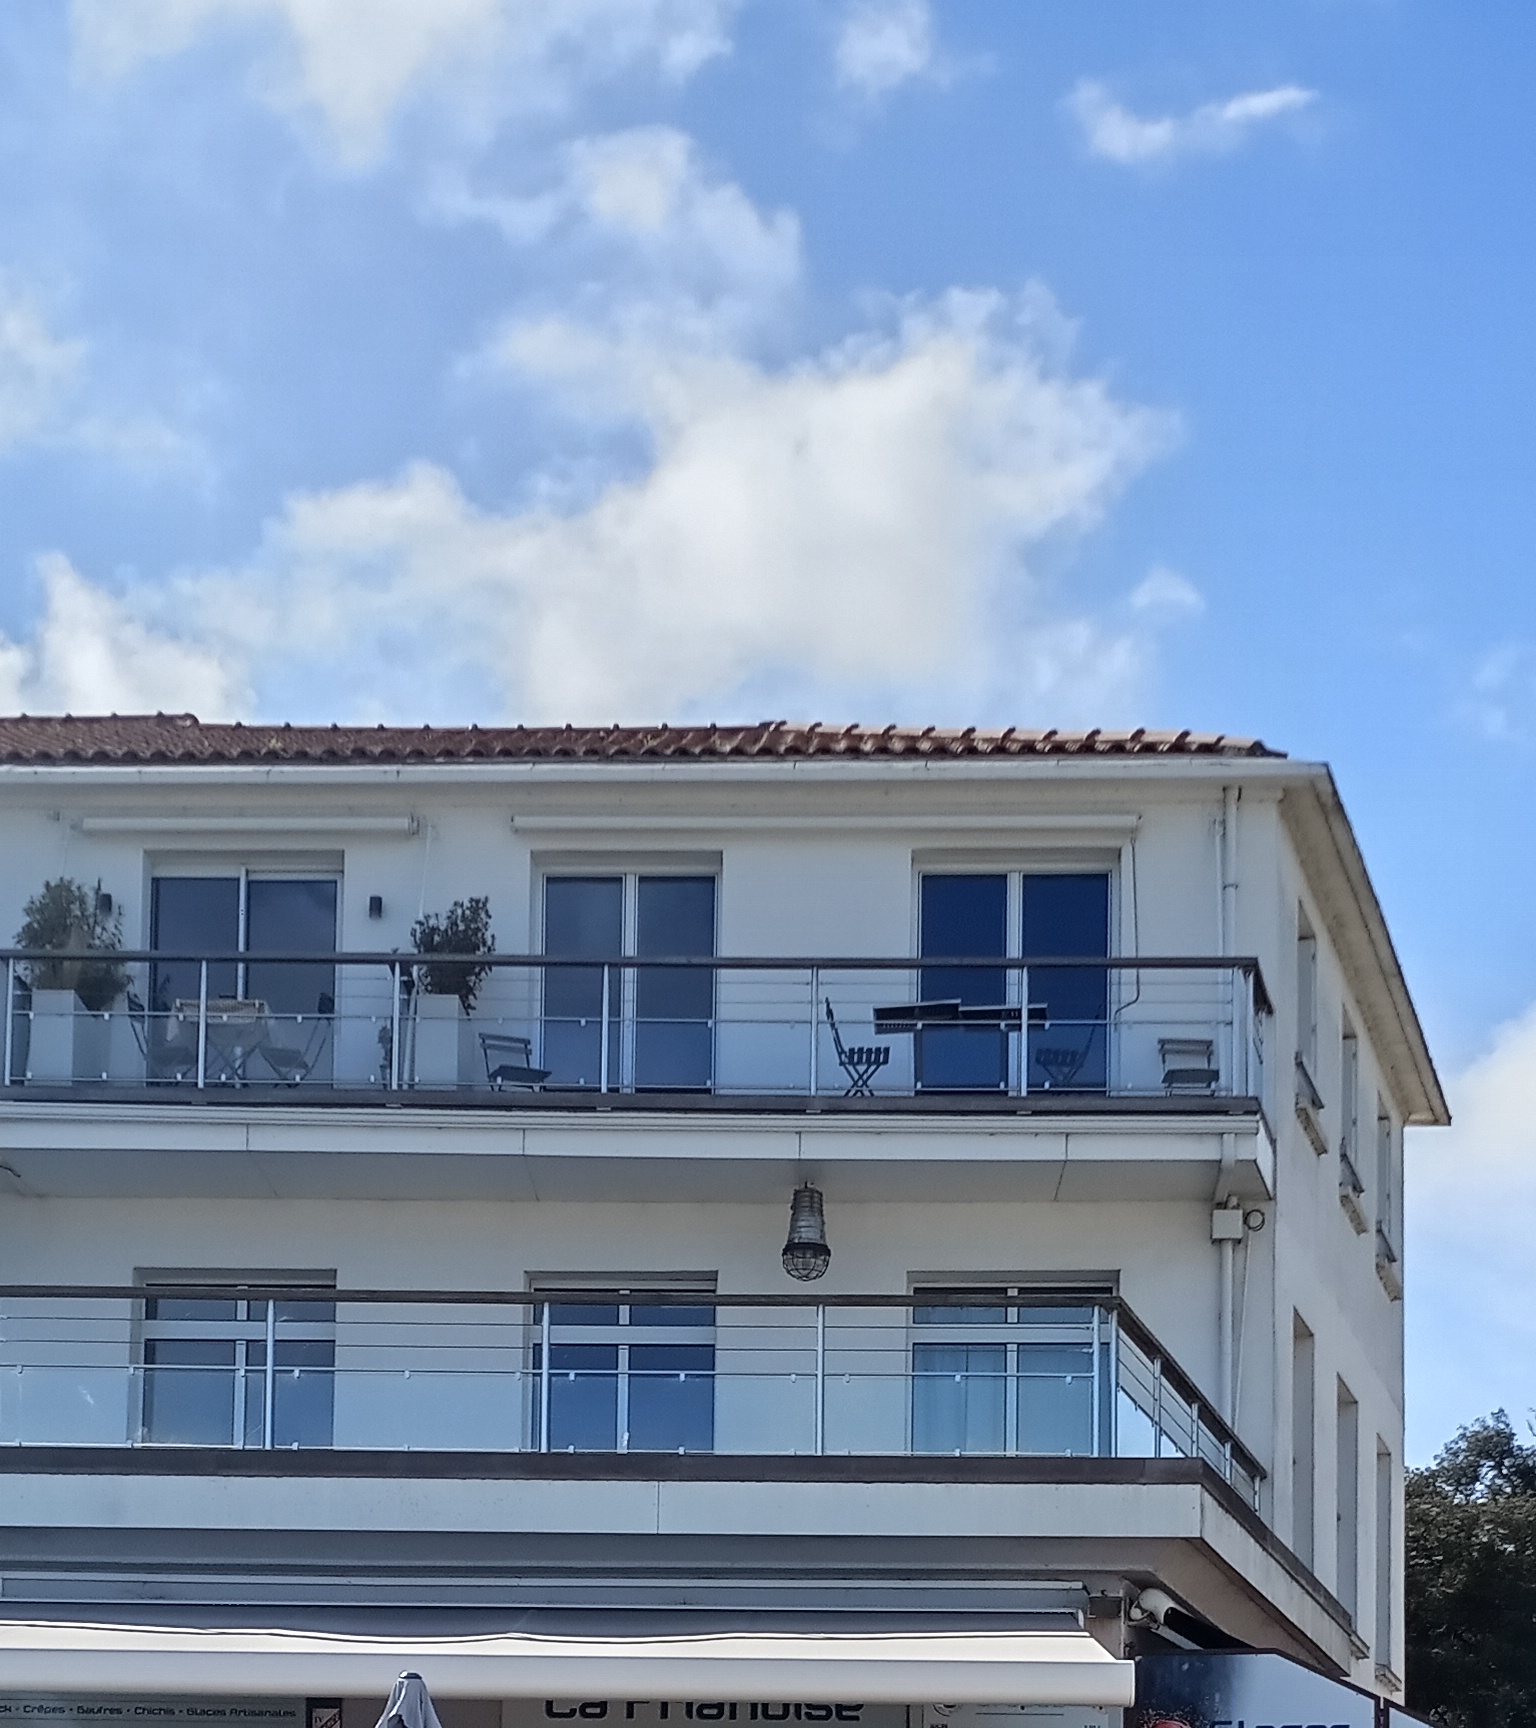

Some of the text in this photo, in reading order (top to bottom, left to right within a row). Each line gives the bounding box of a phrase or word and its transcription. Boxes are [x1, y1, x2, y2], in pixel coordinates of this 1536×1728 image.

[22, 1704, 66, 1716] Crêpes
[76, 1704, 123, 1715] Gaufres
[134, 1705, 176, 1716] Chichis
[186, 1707, 226, 1718] Glaces
[229, 1708, 297, 1718] Artisanales
